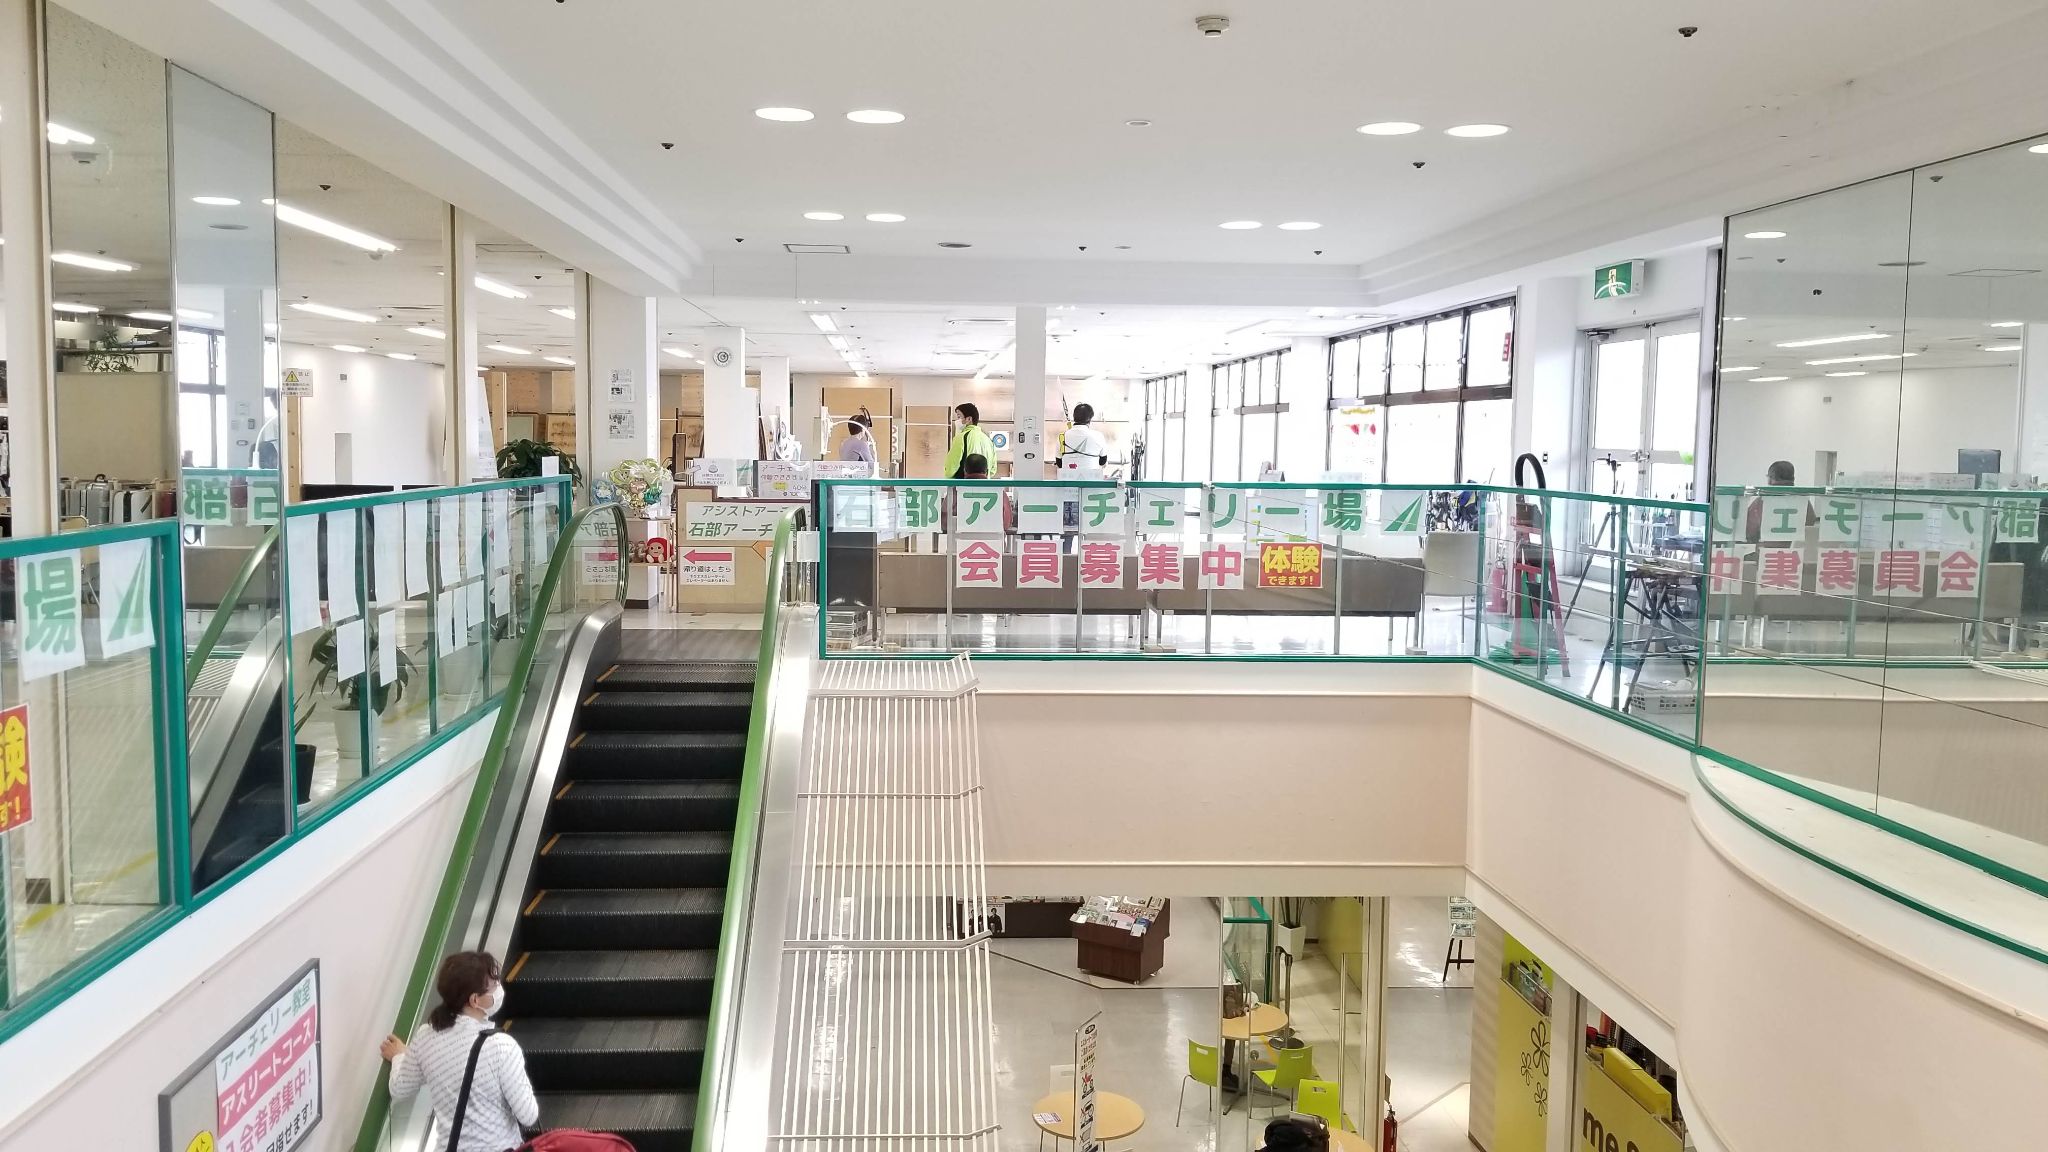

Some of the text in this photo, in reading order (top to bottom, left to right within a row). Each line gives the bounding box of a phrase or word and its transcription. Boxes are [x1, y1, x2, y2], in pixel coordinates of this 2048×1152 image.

[688, 521, 773, 537] 石部アーチ
[837, 488, 1363, 531] 石部アーチェリー場
[959, 541, 1241, 586] 会員募集中
[1262, 545, 1320, 573] 体験
[1267, 575, 1313, 586] できます!
[23, 556, 76, 654] 場
[222, 978, 311, 1081] アーチェリー教室
[222, 1018, 312, 1126] アスリートコース
